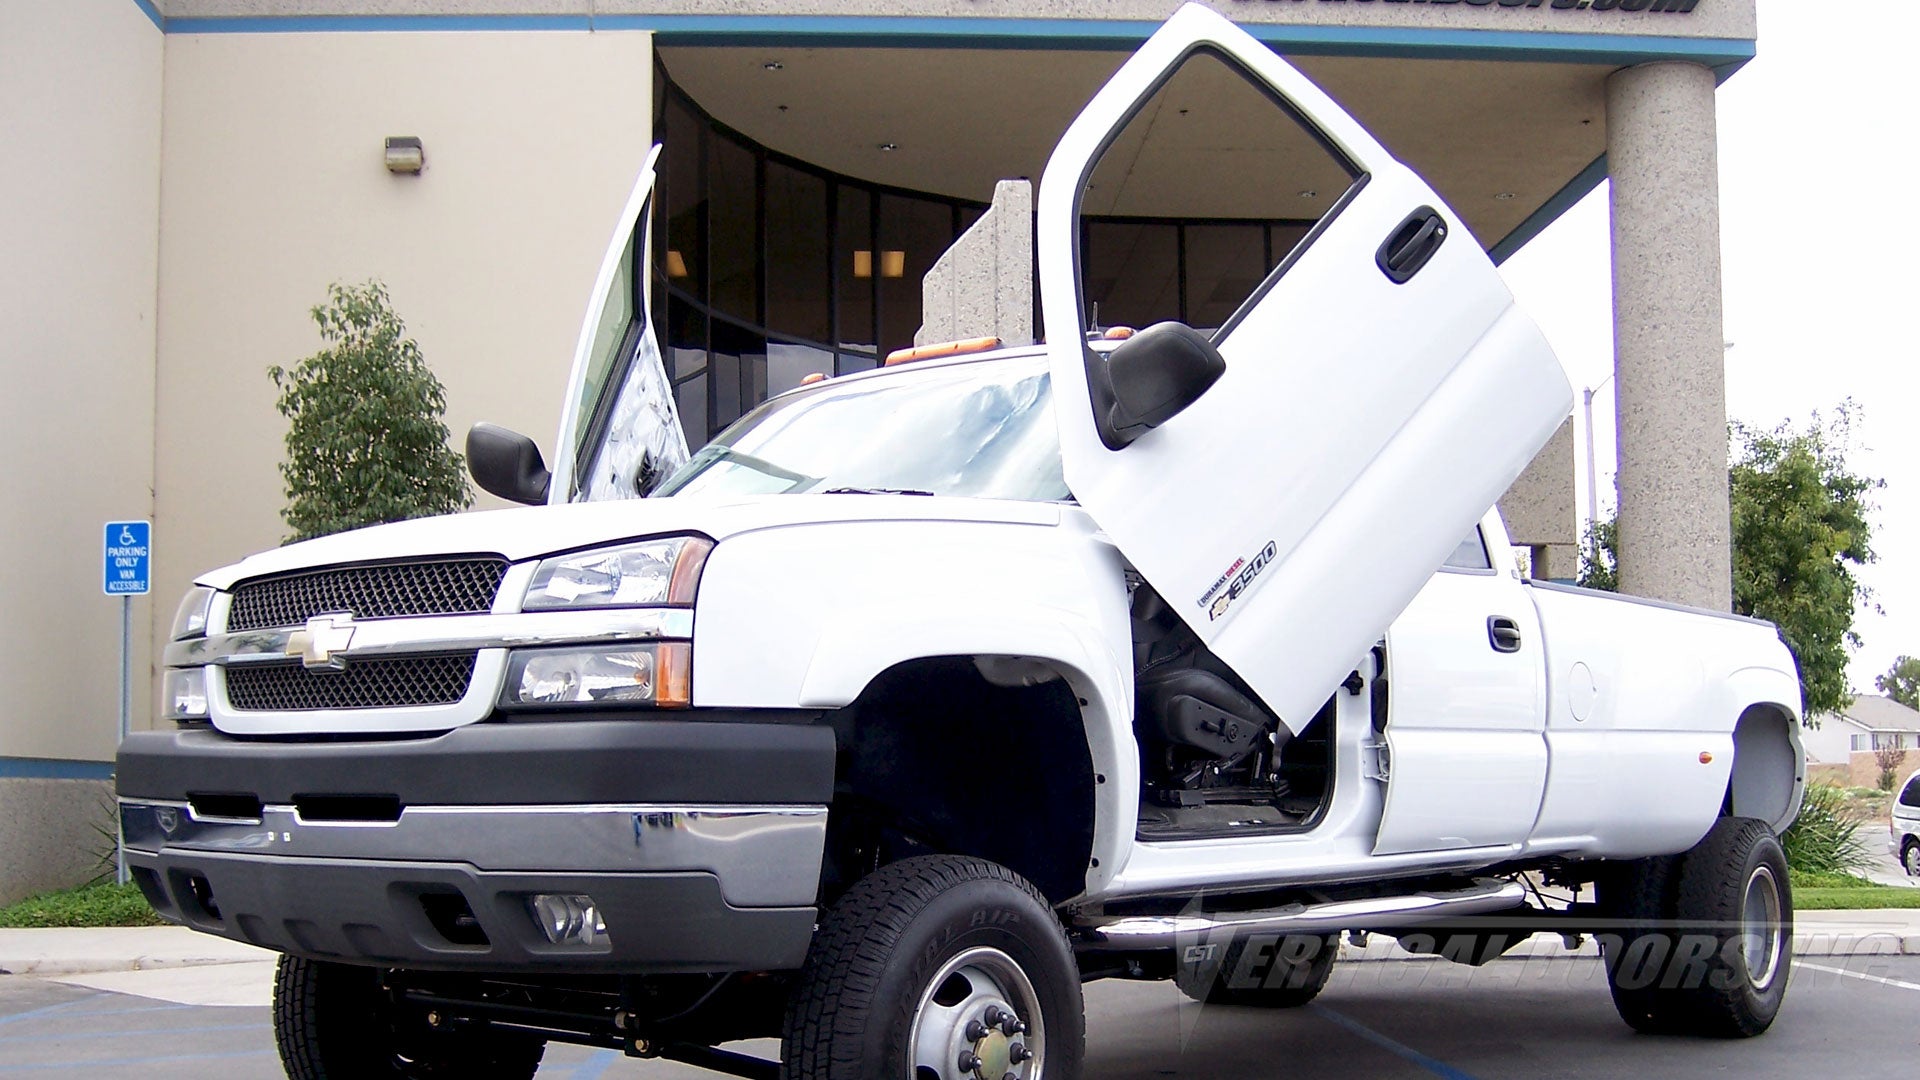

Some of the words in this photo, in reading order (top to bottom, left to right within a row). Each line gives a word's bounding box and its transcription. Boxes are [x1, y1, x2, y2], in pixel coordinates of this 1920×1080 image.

[108, 546, 147, 557] PARKING
[115, 557, 139, 568] ONLY
[119, 569, 135, 579] VAN
[1230, 540, 1277, 600] 3500
[108, 580, 146, 591] ACCESSIBLE
[1200, 574, 1228, 604] DURAMAX
[1225, 557, 1245, 578] DIESEL
